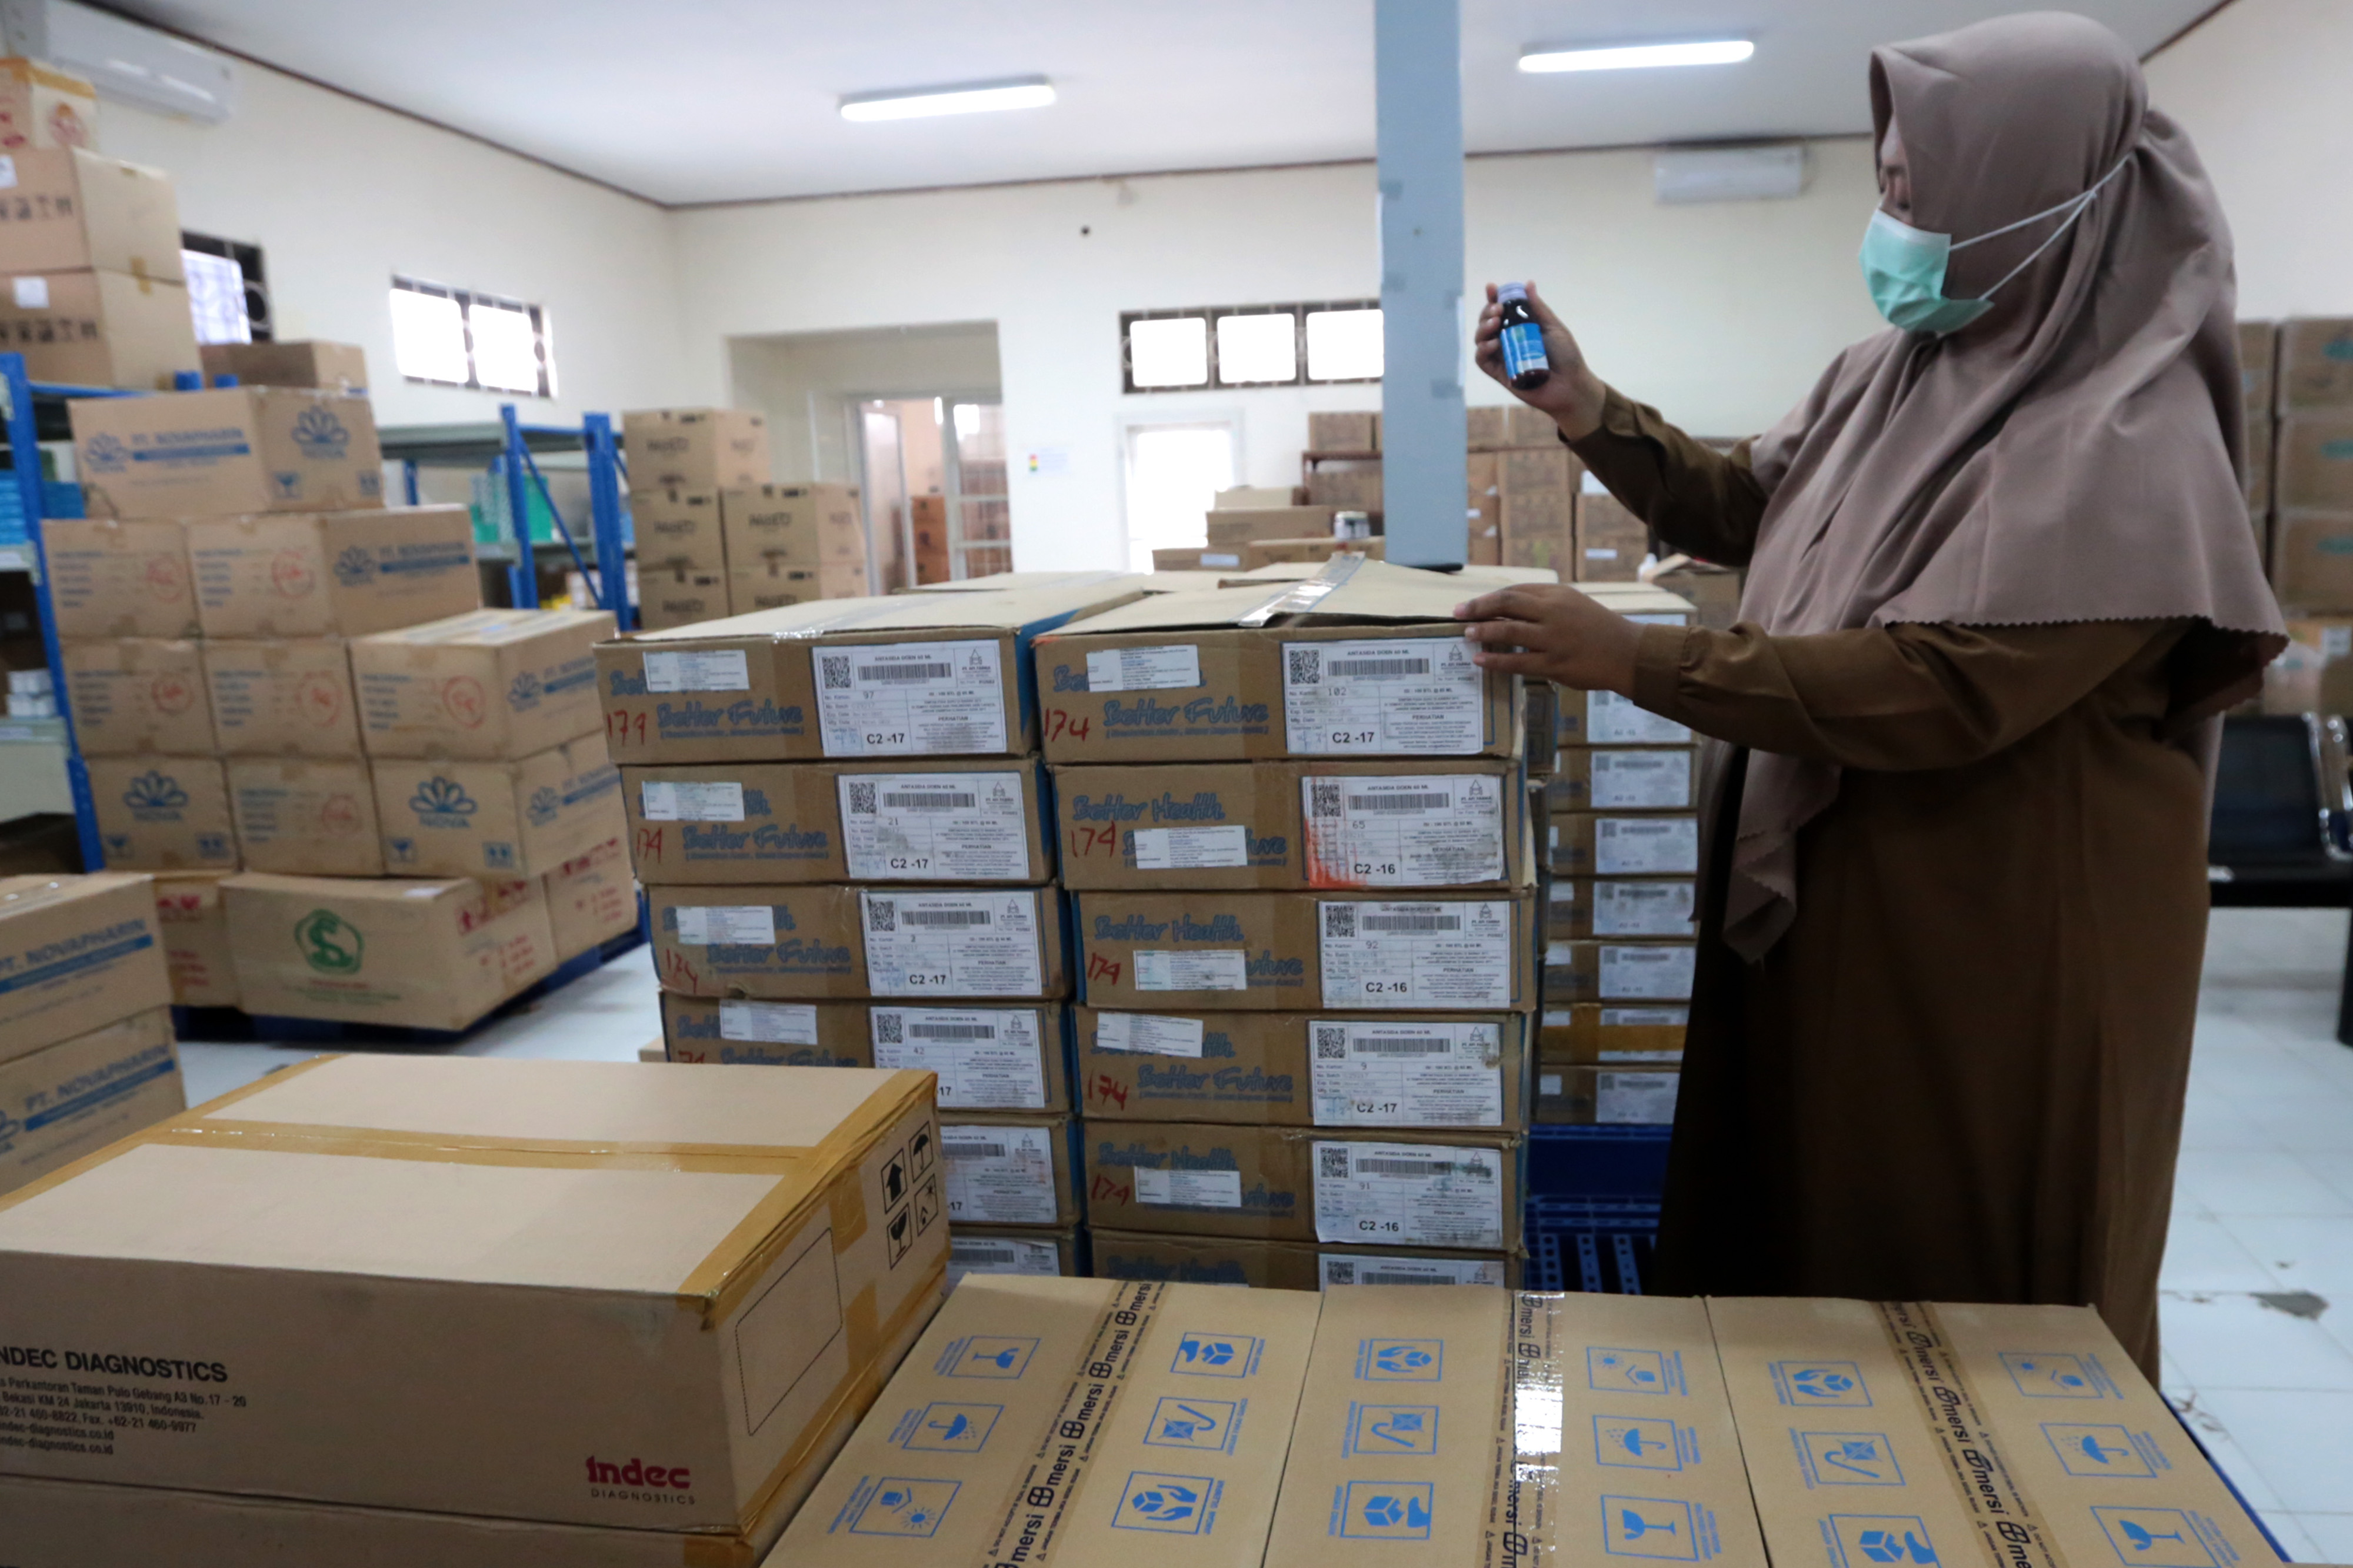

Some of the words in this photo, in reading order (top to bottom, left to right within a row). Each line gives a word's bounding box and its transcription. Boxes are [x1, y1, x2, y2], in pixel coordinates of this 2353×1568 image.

[1328, 688, 1347, 696] 102
[1044, 709, 1090, 741] 174
[1103, 699, 1180, 726] Better
[1185, 696, 1269, 723] Future
[1073, 794, 1149, 820] Better
[683, 825, 751, 849] Better
[753, 823, 828, 849] Future
[1071, 820, 1116, 858] 174
[1095, 914, 1169, 940] Better
[1365, 941, 1378, 949] 92
[1088, 952, 1121, 985] 174
[1088, 1069, 1128, 1111] 174
[1137, 1063, 1211, 1089] Better
[1214, 1066, 1293, 1092] Future
[1129, 1282, 1153, 1312] mersi
[1519, 1307, 1535, 1339] mersi
[1104, 1329, 1131, 1363] mersi
[65, 1351, 228, 1383] DIAGNOSTICS
[1914, 1346, 1945, 1383] mersi
[2, 1391, 35, 1404] Bekasi
[39, 1394, 54, 1405] KM
[58, 1396, 69, 1407] 24
[74, 1397, 111, 1411] Jakarta
[71, 1383, 104, 1396] Taman
[108, 1386, 131, 1399] Pulo
[132, 1388, 172, 1404] Gebang
[175, 1392, 188, 1403] A3
[233, 1396, 246, 1407] 20
[1077, 1383, 1105, 1421] mersi
[82, 1413, 103, 1425] Fax.
[108, 1416, 144, 1429] +62-21
[1942, 1404, 1974, 1443] mersi
[1046, 1444, 1076, 1486] mersi
[591, 1489, 695, 1505] DIAGNOSTICS
[1972, 1470, 2010, 1515] mersi
[1011, 1513, 1045, 1563] mersi
